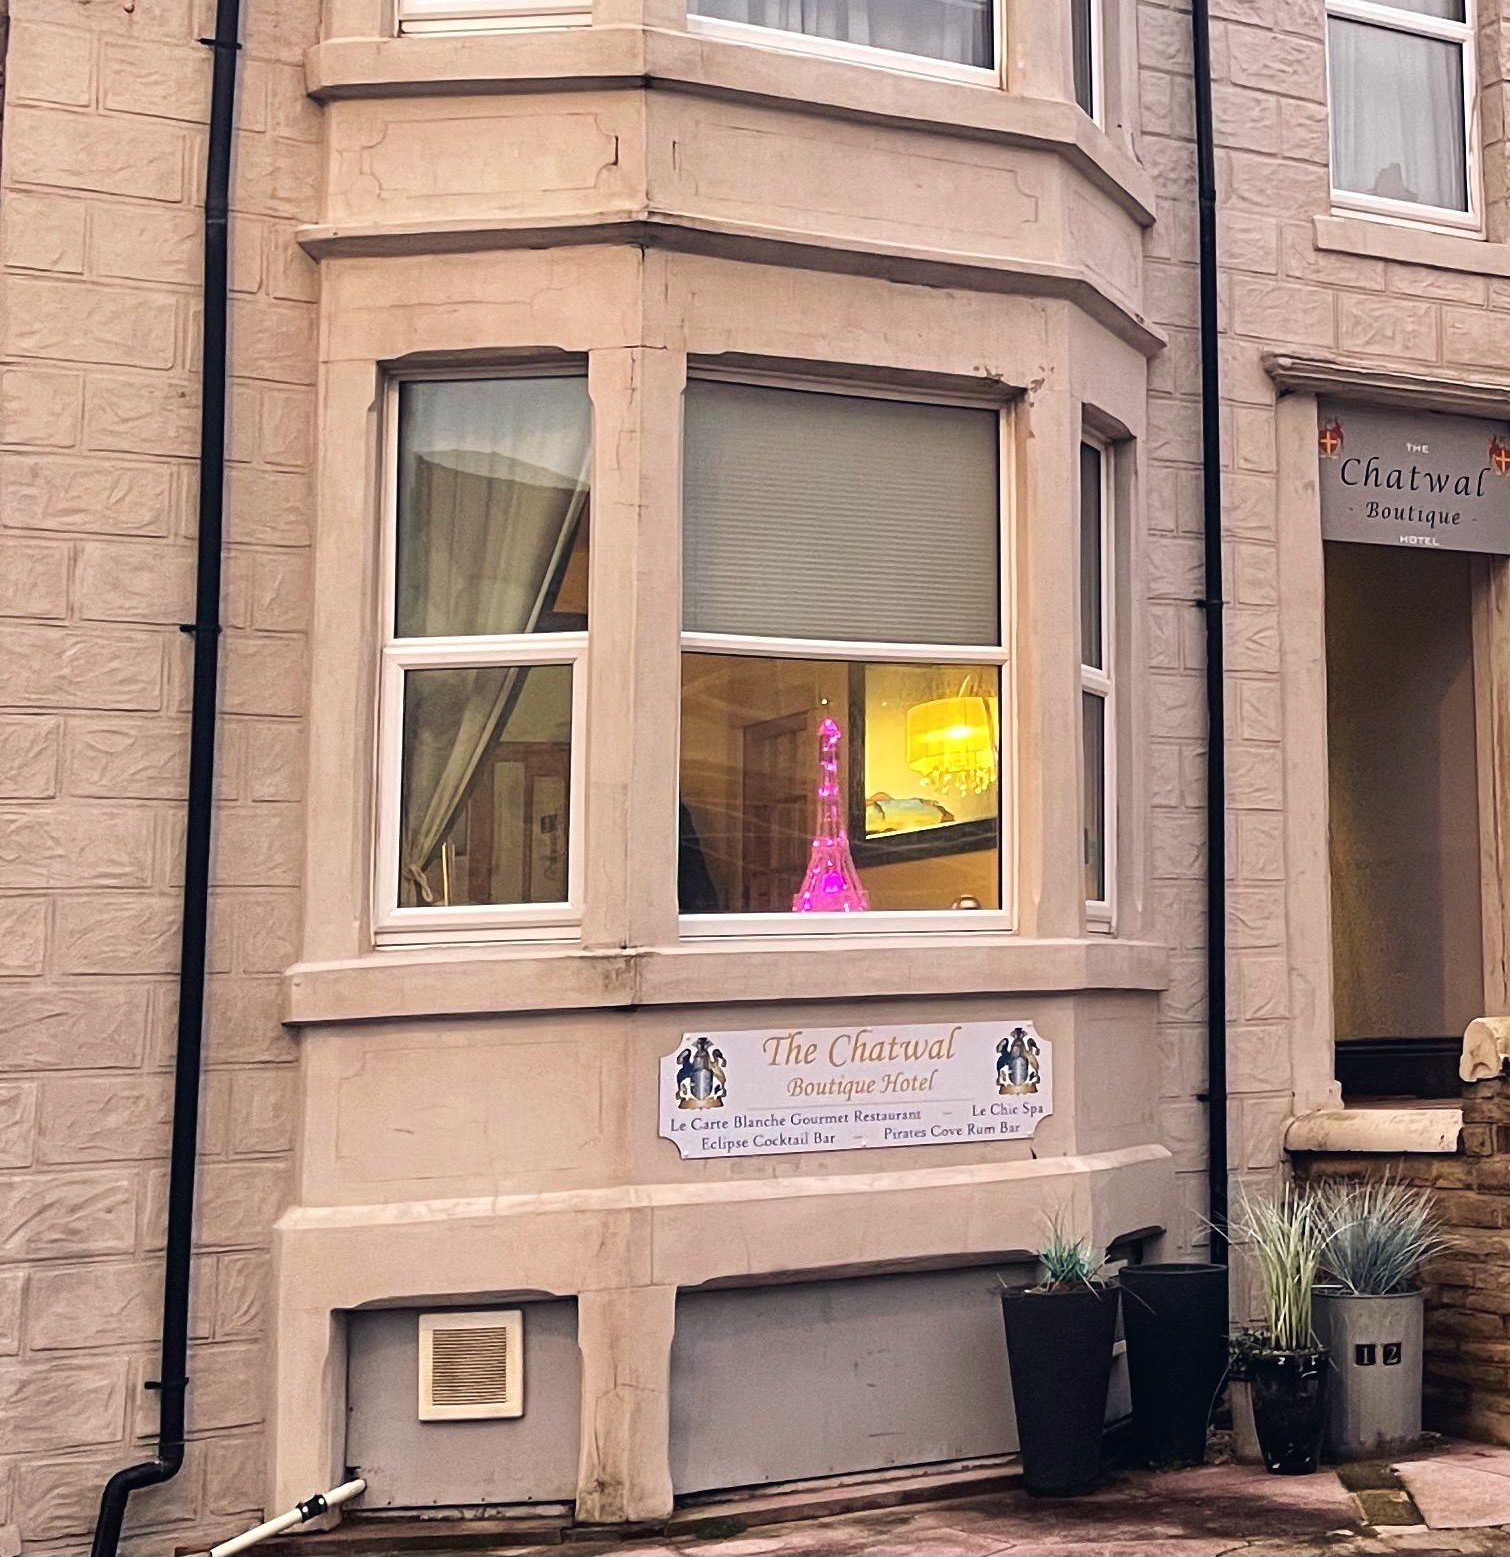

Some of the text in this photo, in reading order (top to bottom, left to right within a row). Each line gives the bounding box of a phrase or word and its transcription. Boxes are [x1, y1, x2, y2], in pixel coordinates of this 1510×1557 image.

[1406, 443, 1430, 454] THE
[1341, 456, 1492, 497] Chatwal
[1365, 501, 1461, 529] Boutique
[1399, 535, 1440, 546] HOTEL
[763, 1026, 963, 1068] The Chatwal
[787, 1069, 939, 1102] Boutique Hotel
[670, 1118, 687, 1132] Le
[690, 1117, 729, 1131] Carte
[734, 1114, 786, 1129] Blanche
[790, 1113, 849, 1126] Gourmet
[854, 1110, 922, 1123] Restaurant
[972, 1104, 987, 1117] Le
[990, 1102, 1018, 1116] Chic
[1022, 1102, 1044, 1118] Spa
[702, 1137, 750, 1153] Eclipse
[753, 1132, 809, 1148] Cocktail
[814, 1131, 836, 1145] Bar
[884, 1128, 927, 1140] Pirates
[930, 1125, 963, 1137] Cove
[967, 1123, 996, 1136] Rum
[1000, 1122, 1021, 1134] Bar
